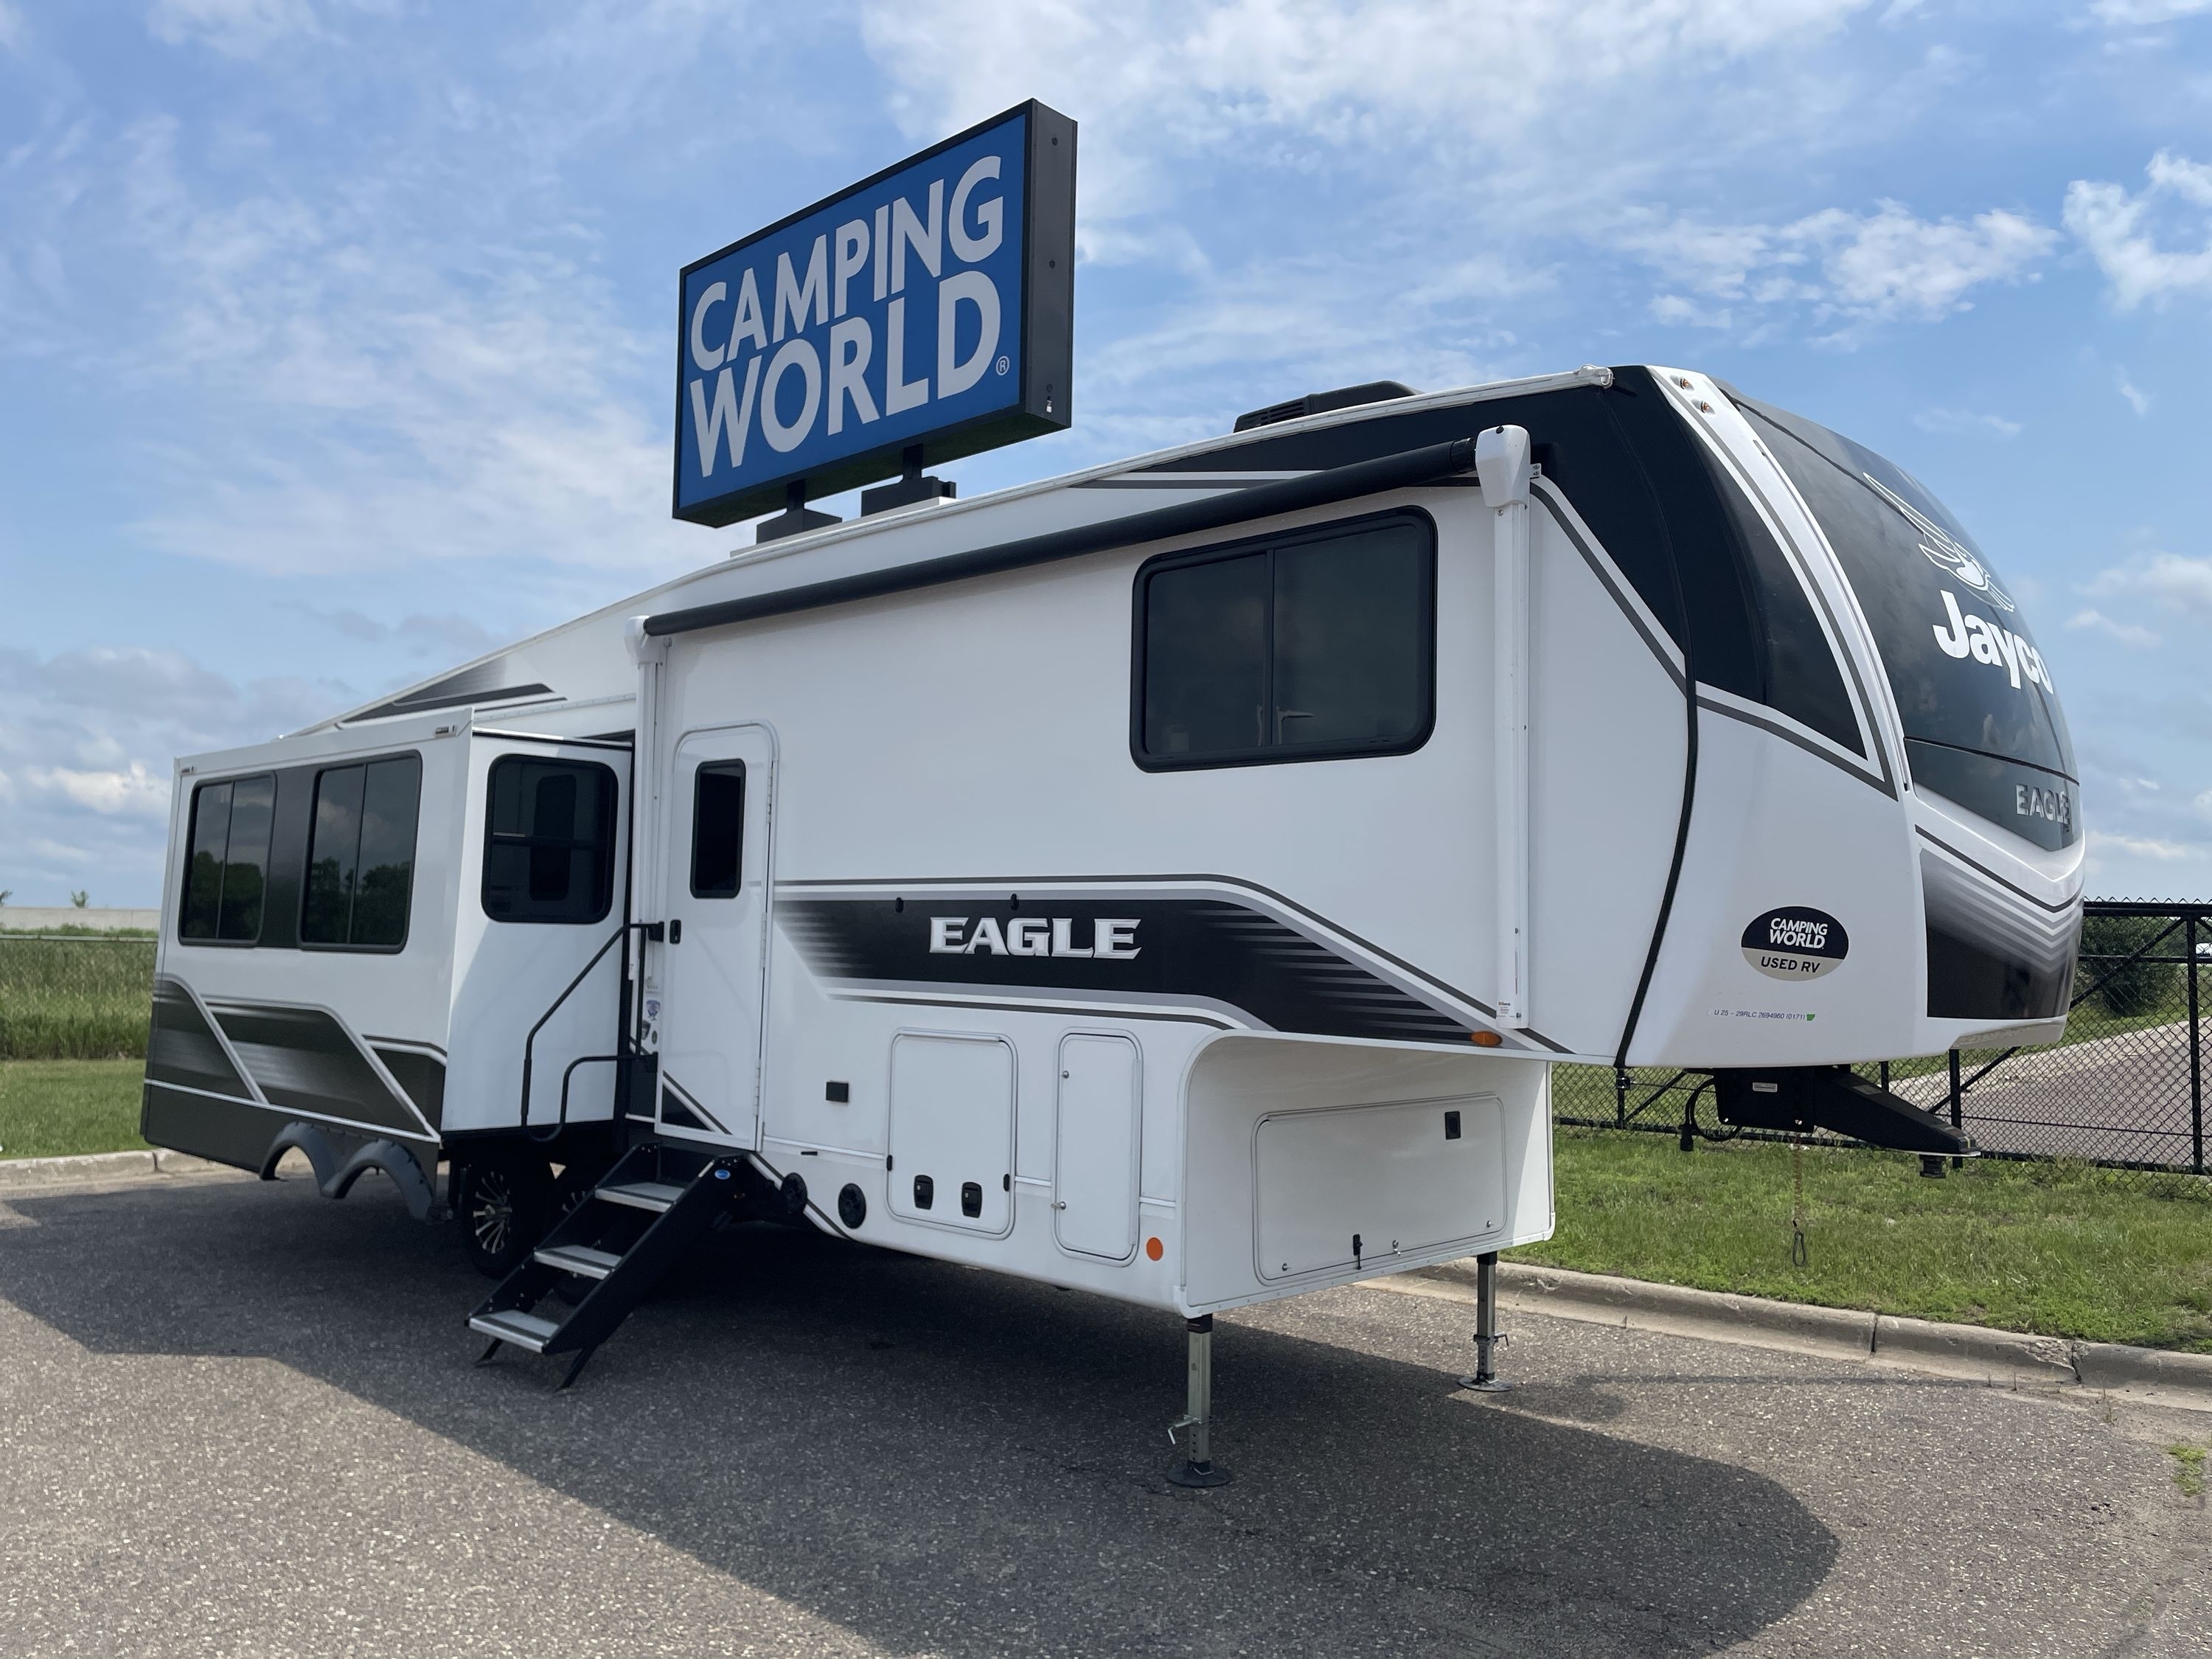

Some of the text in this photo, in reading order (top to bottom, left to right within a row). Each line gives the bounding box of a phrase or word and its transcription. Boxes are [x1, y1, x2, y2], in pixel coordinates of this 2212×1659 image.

[690, 155, 1004, 371] CAMPING
[1932, 589, 2054, 695] Jayco
[929, 917, 1142, 959] EAGLE
[1770, 917, 1829, 936] CAMPING
[1761, 956, 1820, 973] USED RV
[1758, 1012, 1785, 1020] 2694960
